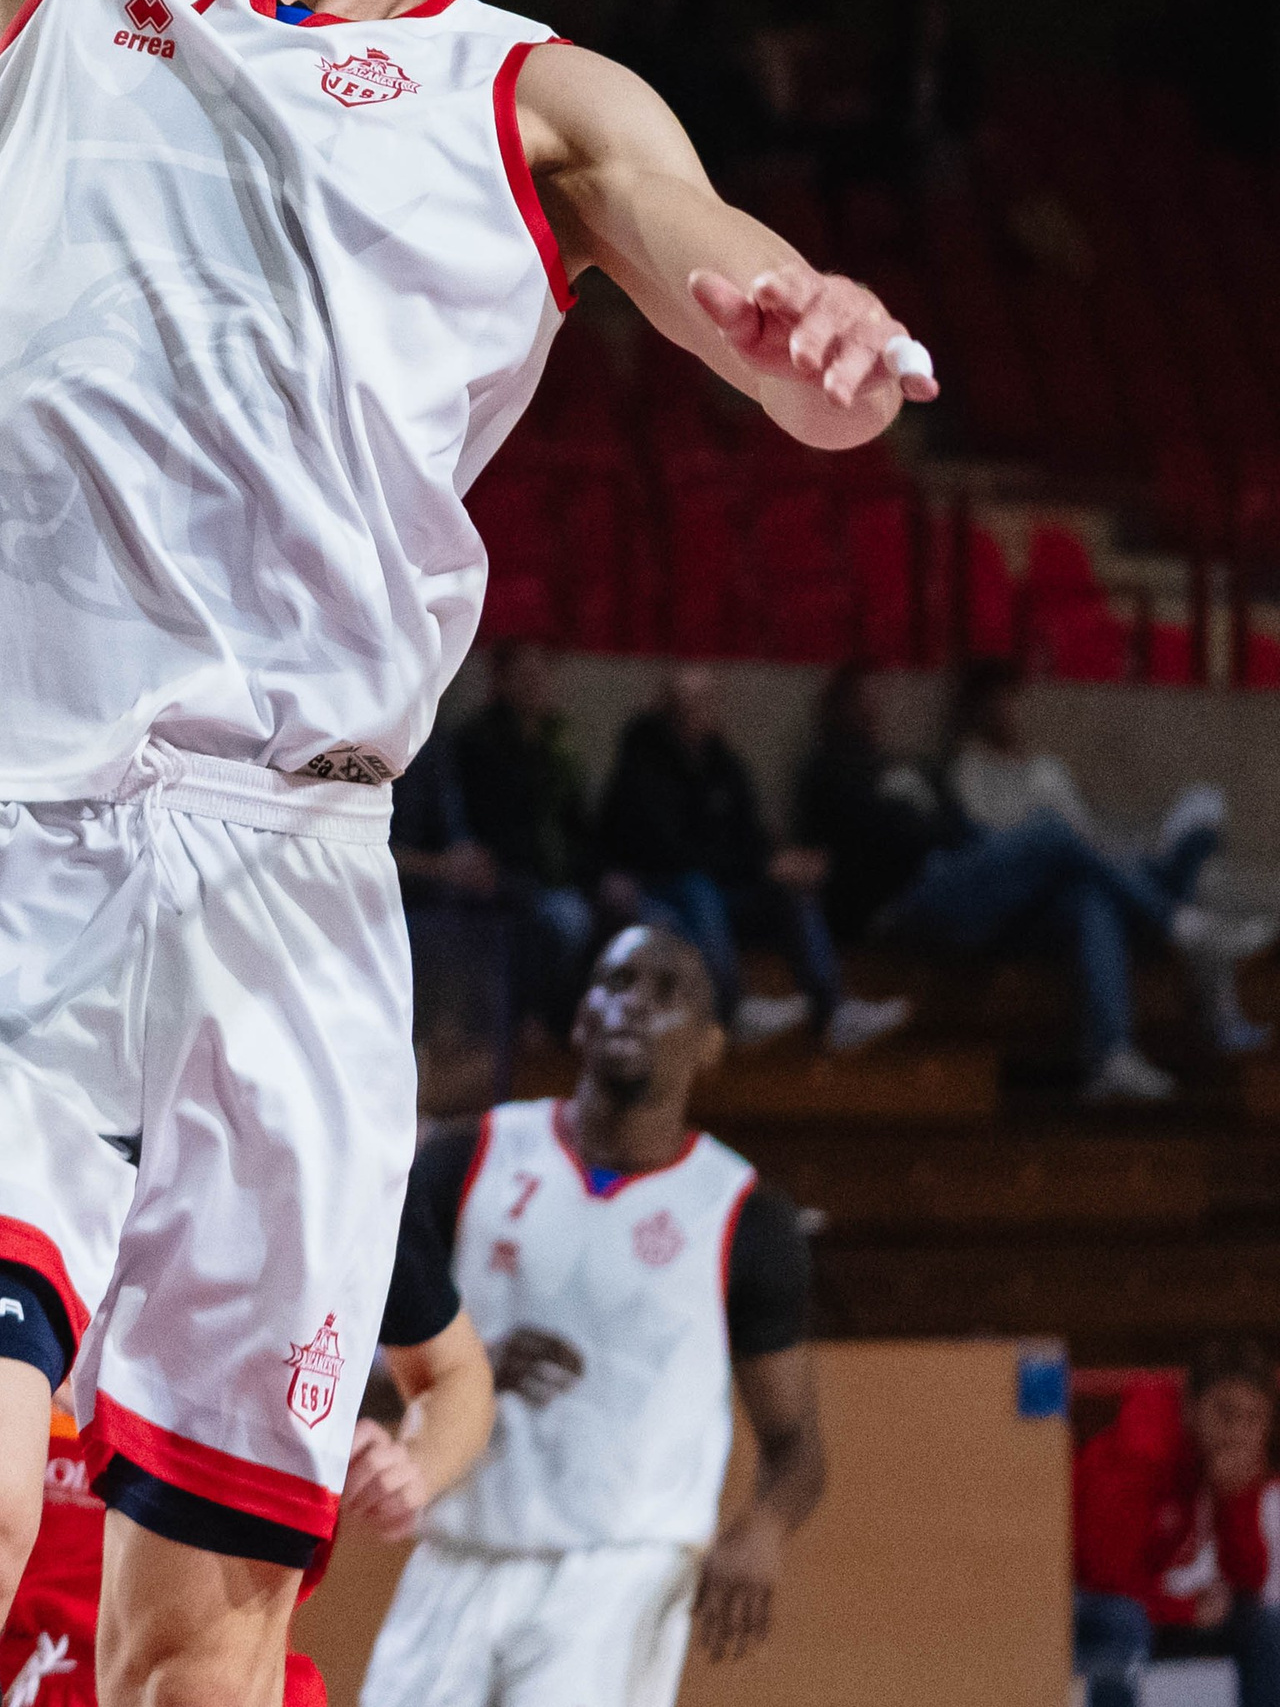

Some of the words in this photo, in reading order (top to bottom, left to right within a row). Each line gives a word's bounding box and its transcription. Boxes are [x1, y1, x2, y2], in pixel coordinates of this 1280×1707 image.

[114, 27, 176, 59] errea
[328, 75, 389, 100] JESI
[508, 1169, 542, 1222] 7
